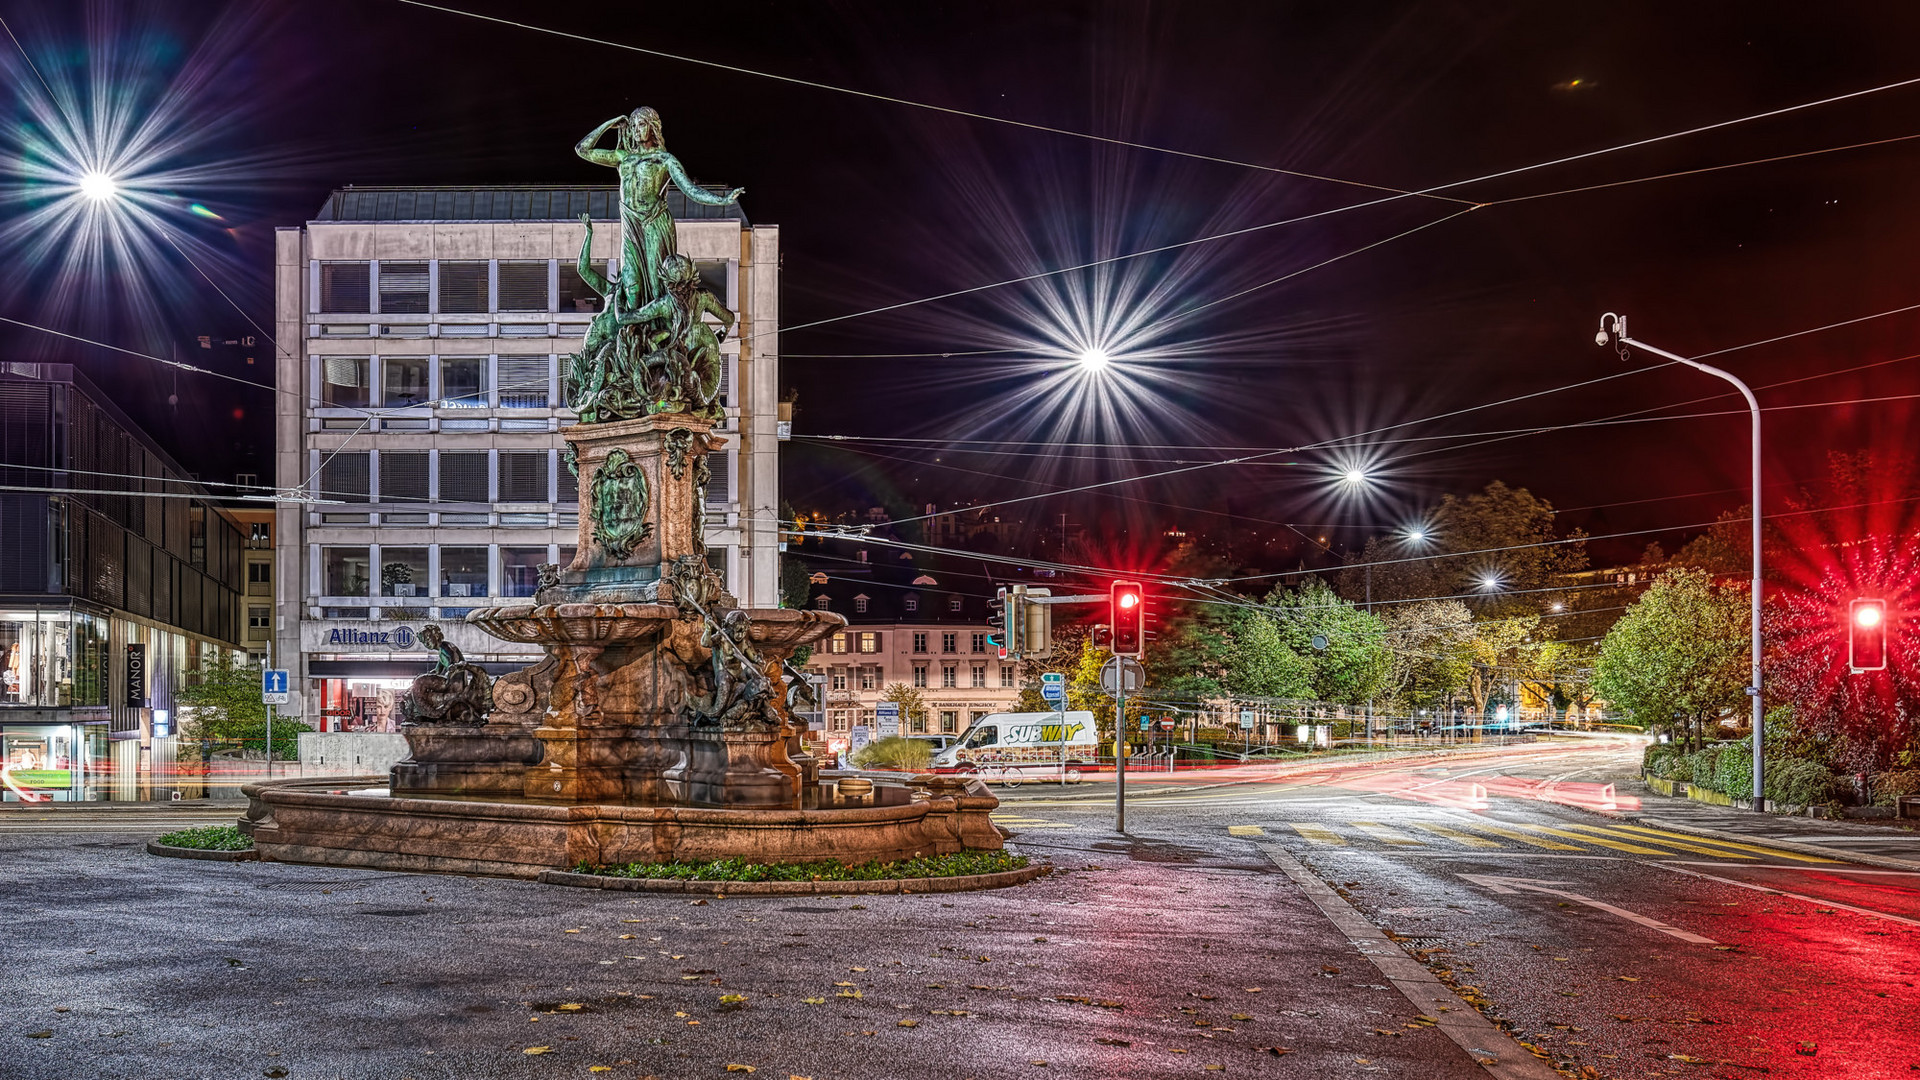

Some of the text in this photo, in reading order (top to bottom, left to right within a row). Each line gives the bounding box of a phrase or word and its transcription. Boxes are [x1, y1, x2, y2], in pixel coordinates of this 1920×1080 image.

[329, 628, 389, 644] Allianz
[130, 651, 141, 700] MANOR
[1004, 721, 1085, 745] SUBWAY
